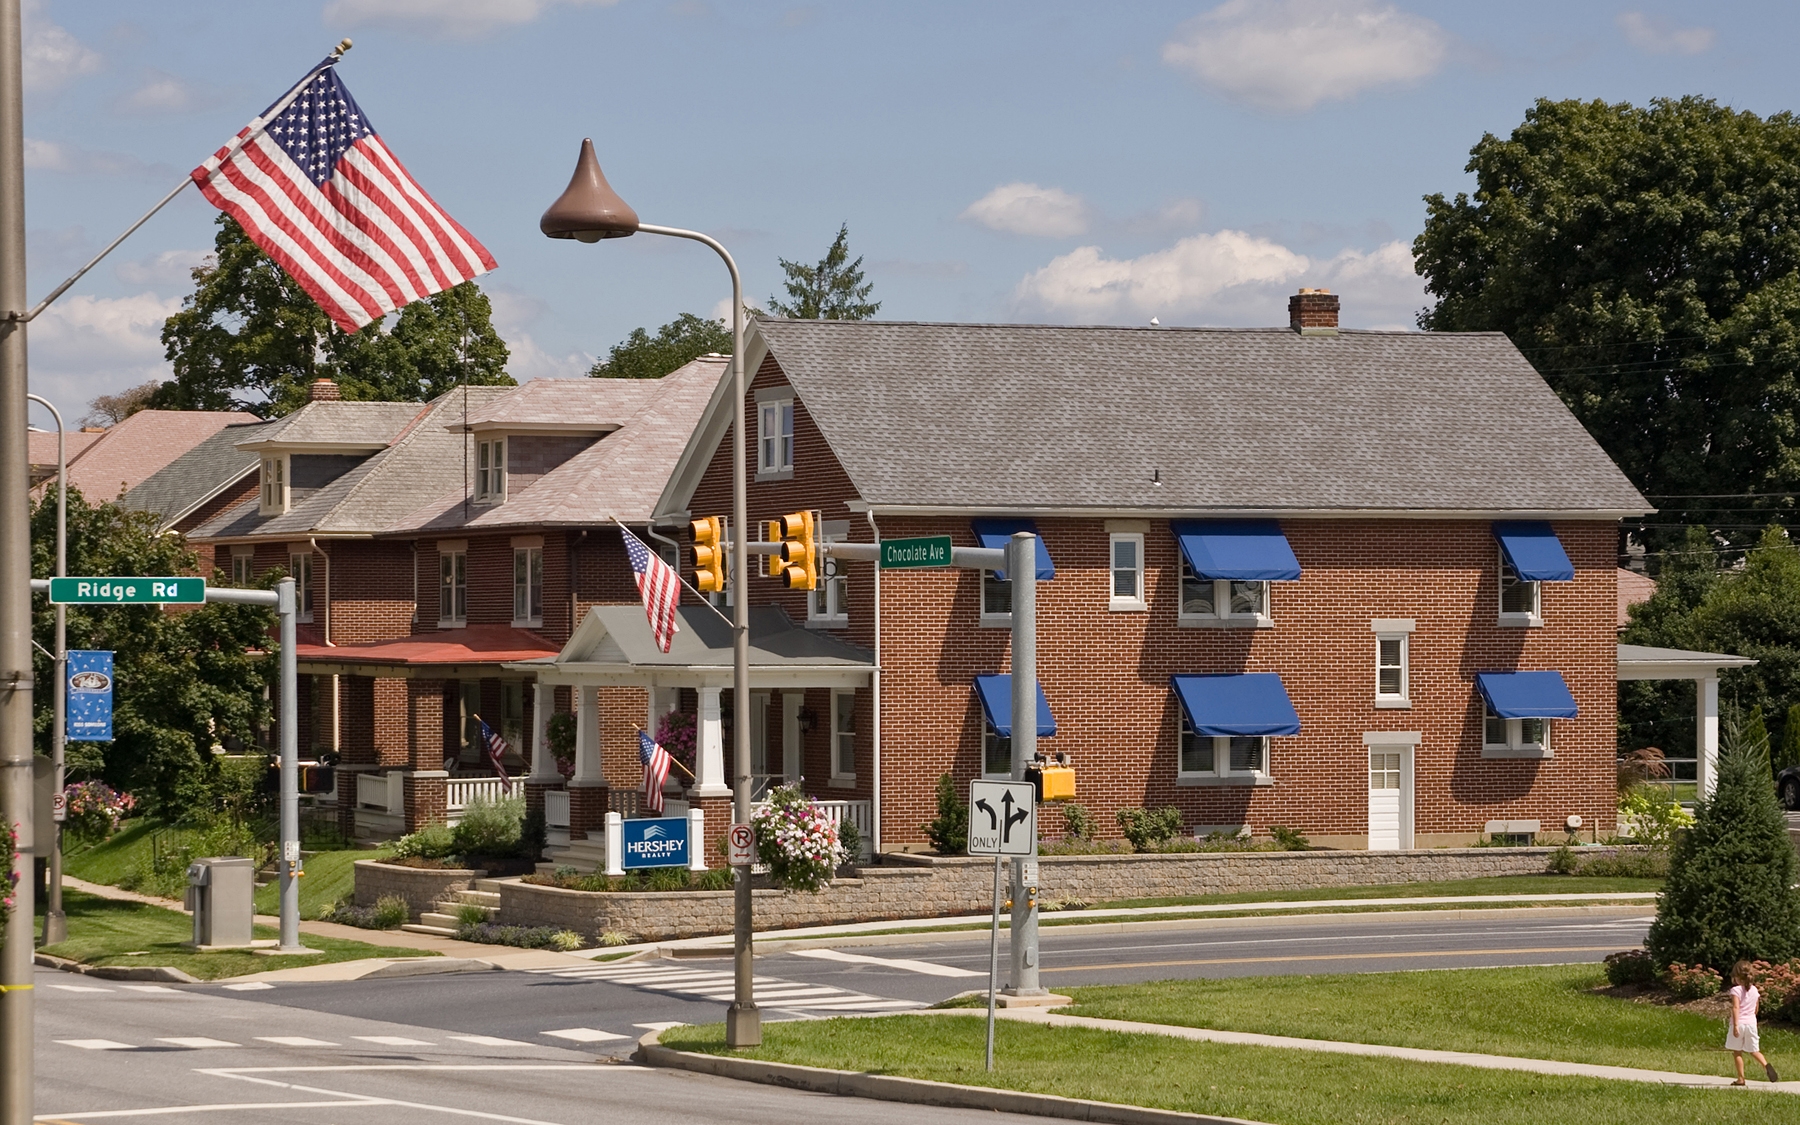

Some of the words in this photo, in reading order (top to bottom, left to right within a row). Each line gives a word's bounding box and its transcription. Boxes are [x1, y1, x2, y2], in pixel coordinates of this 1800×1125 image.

[887, 545, 927, 562] Chocolate
[929, 544, 944, 560] Ave
[77, 582, 137, 601] Ridge
[152, 582, 178, 597] Rd
[627, 839, 685, 853] HERSHEY
[972, 836, 998, 848] ONLY
